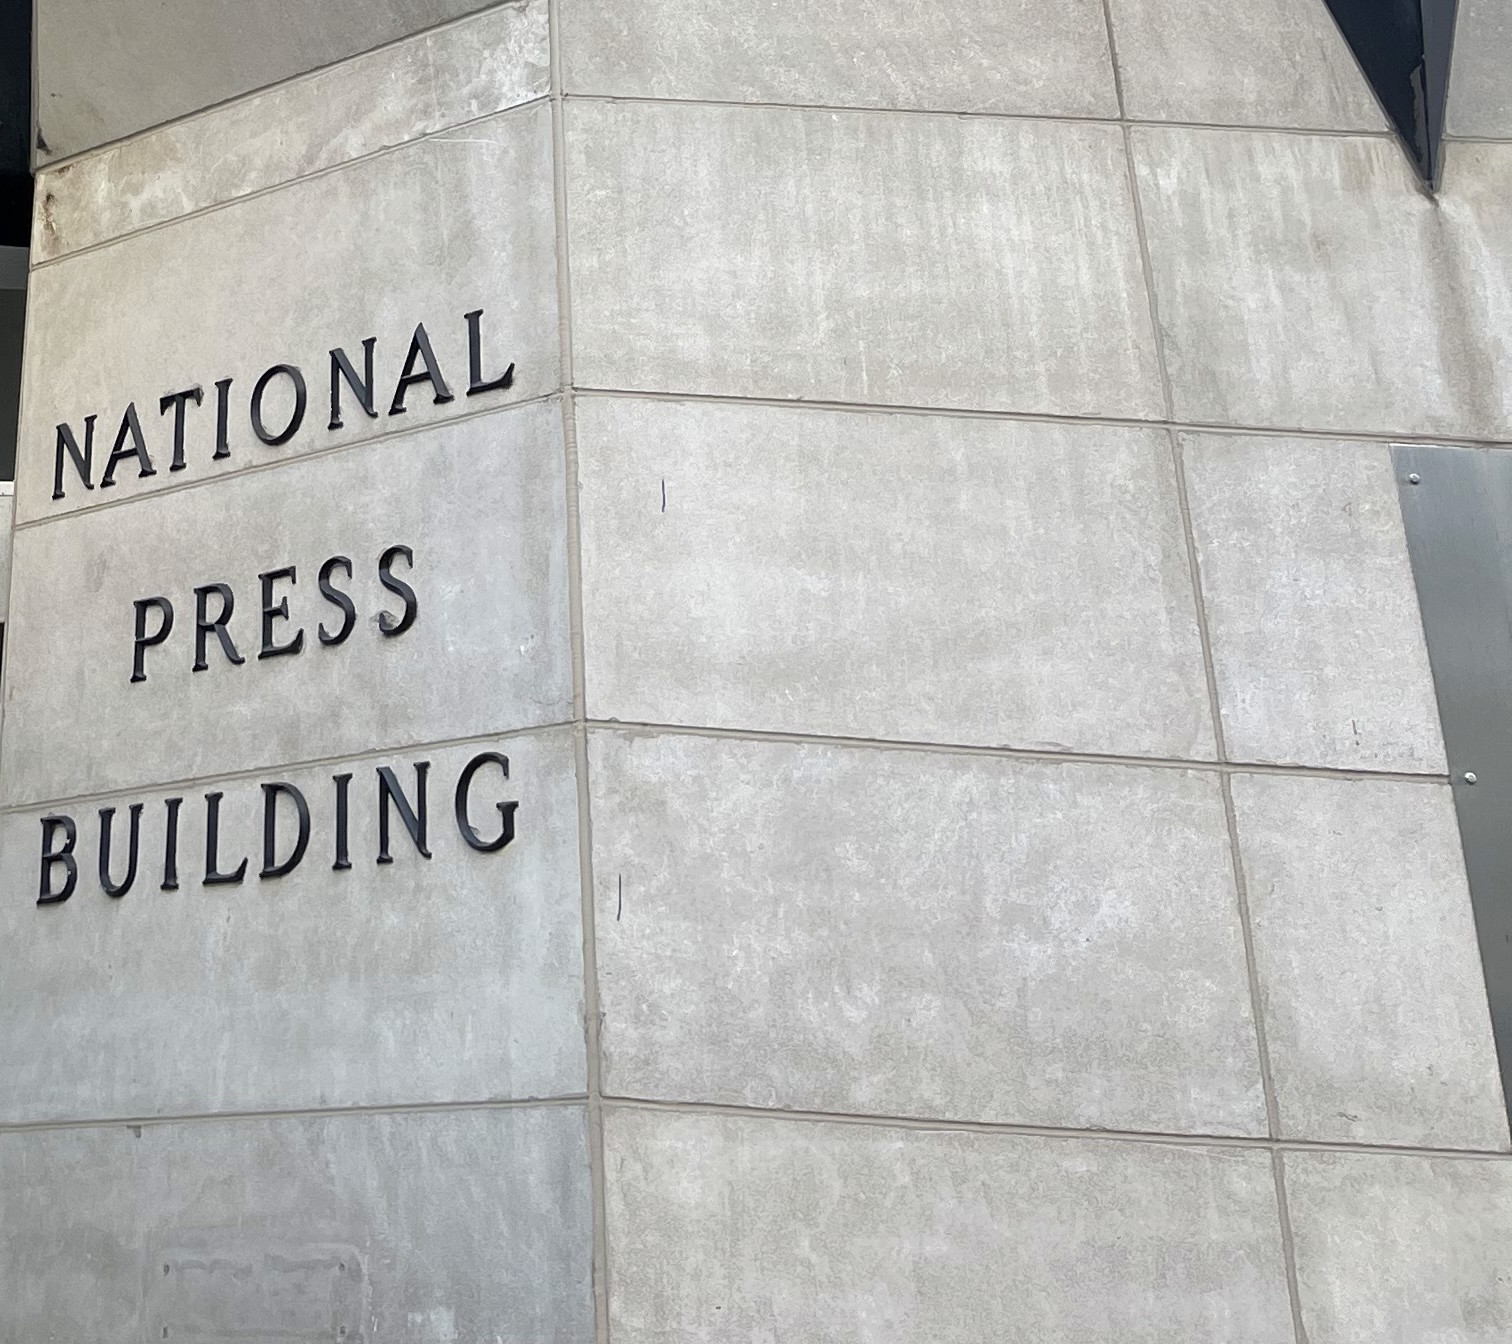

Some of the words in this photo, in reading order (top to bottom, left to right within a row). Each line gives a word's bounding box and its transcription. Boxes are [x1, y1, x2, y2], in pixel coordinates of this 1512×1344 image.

[51, 308, 516, 501] NATIONAL
[129, 544, 418, 684] PRESS
[36, 751, 520, 908] BUILDING
